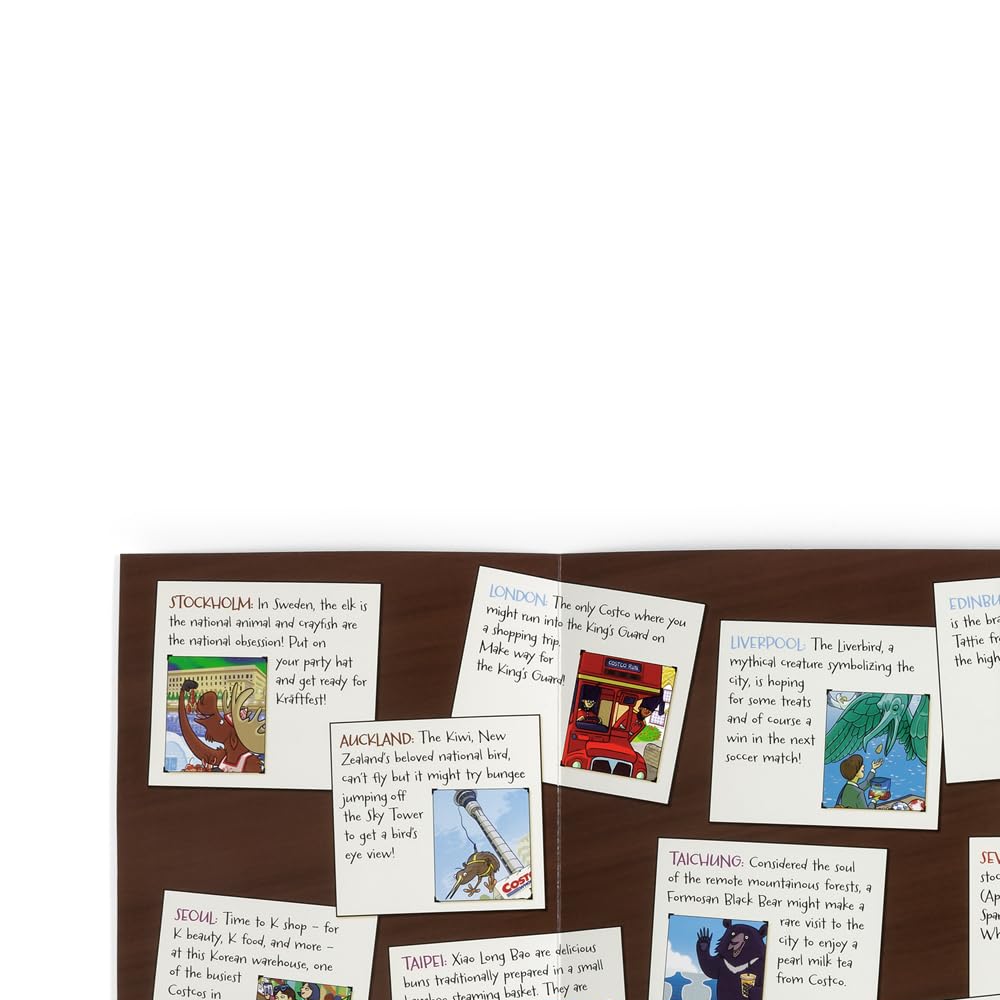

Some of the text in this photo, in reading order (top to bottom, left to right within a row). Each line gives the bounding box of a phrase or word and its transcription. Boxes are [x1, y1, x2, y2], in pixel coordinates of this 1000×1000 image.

[168, 594, 368, 612] STOCKHOLM: In Sweden, the elk is
[489, 583, 687, 631] LONDON: The only Costco where you
[730, 635, 895, 655] LIVERPOOL: The Liverbird, a
[953, 652, 973, 668] the
[476, 657, 566, 687] the King's Guard!
[339, 729, 507, 749] AUCKLAND: The Kiwi, New
[344, 846, 395, 865] eye view!
[668, 850, 856, 873] TAICHUNG: Considered the soul
[400, 943, 597, 972] TAIPEI: Xiao Long Bao are delicious
[169, 964, 243, 984] of the busiest
